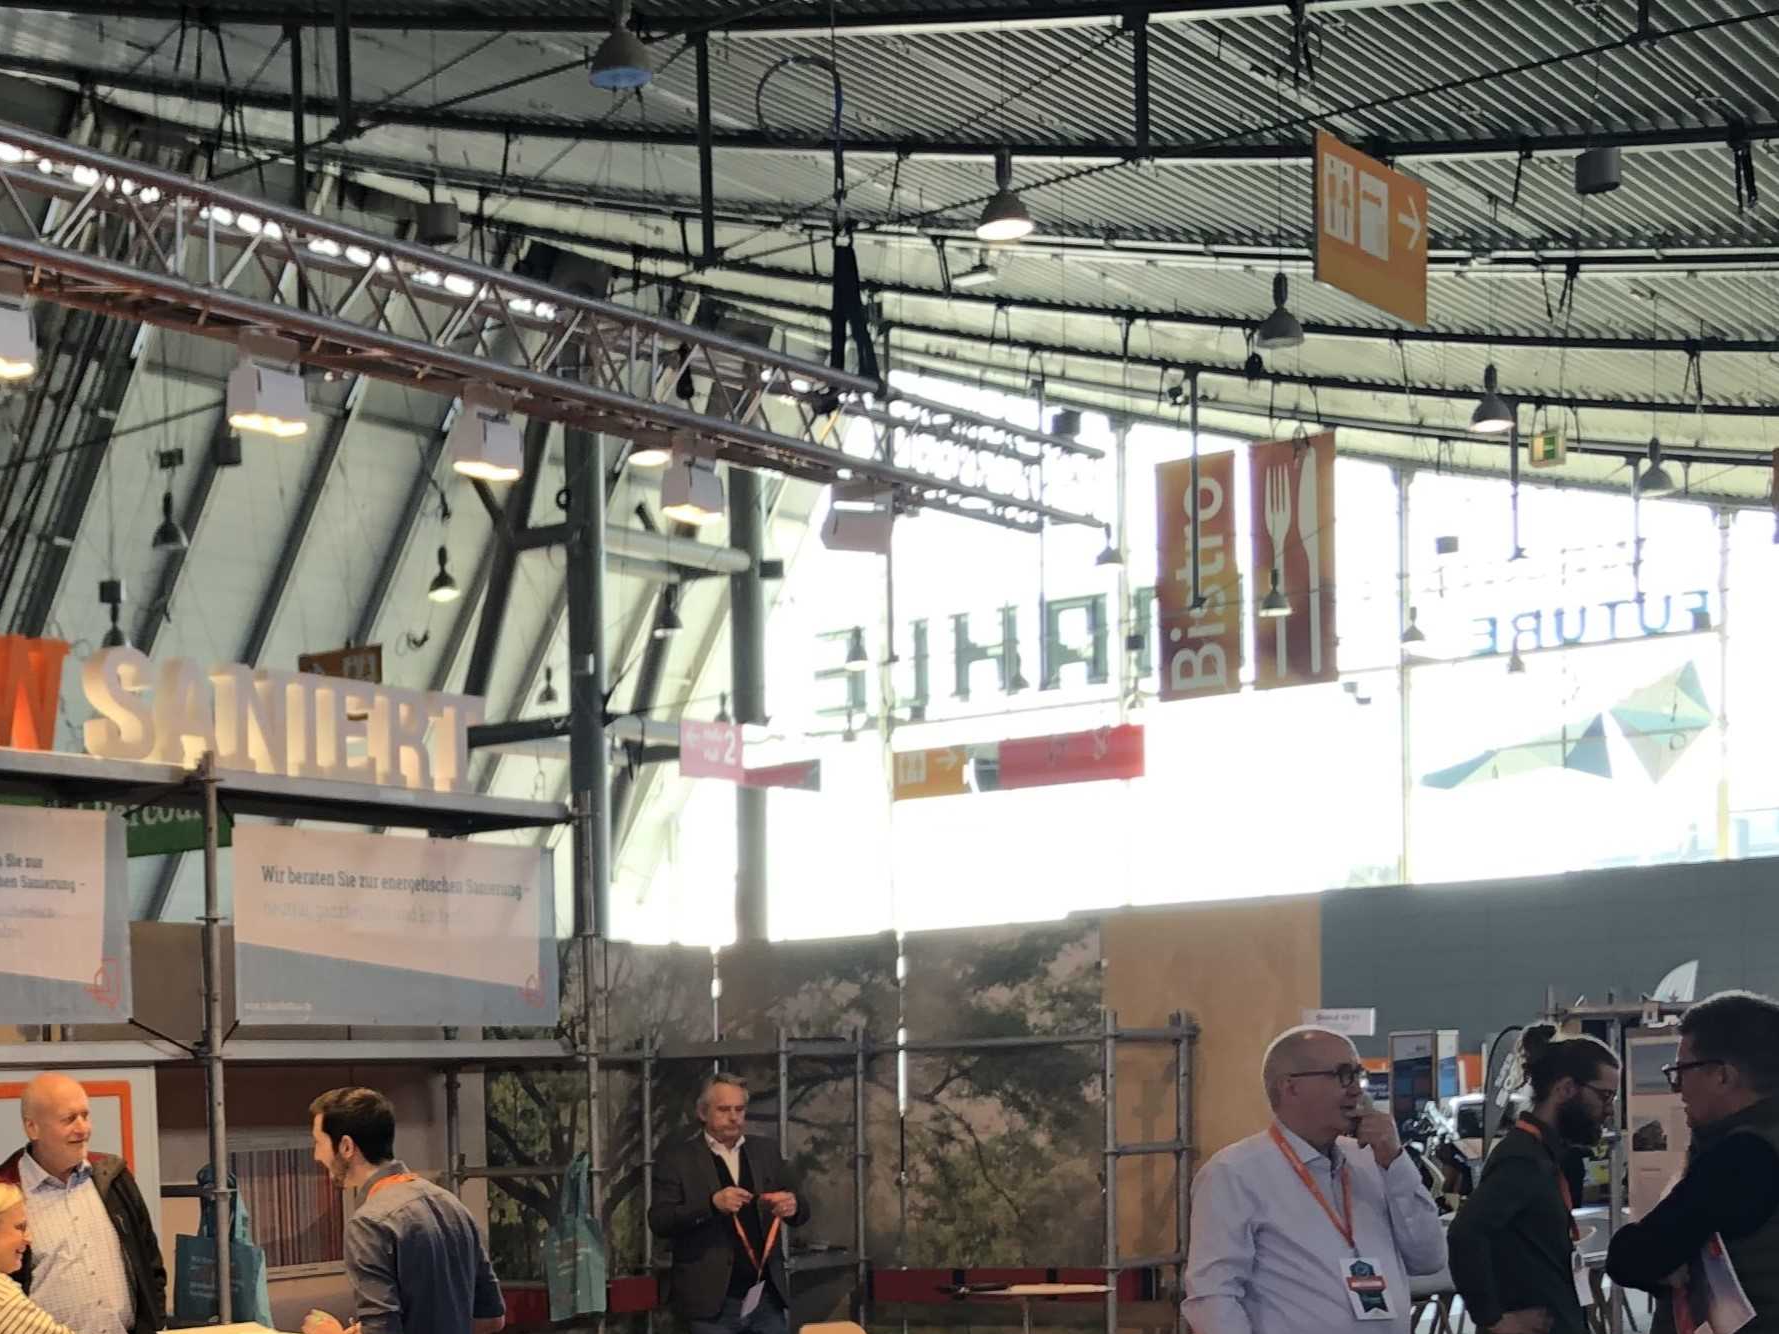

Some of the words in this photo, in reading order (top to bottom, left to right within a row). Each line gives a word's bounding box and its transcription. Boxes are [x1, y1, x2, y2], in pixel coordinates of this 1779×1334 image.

[1171, 475, 1227, 691] Bistro
[81, 646, 485, 793] SANIERT
[262, 866, 284, 883] Wir
[288, 867, 334, 886] beraten
[338, 870, 356, 888] Sie
[360, 875, 378, 889] zur
[382, 876, 462, 894] energetischen
